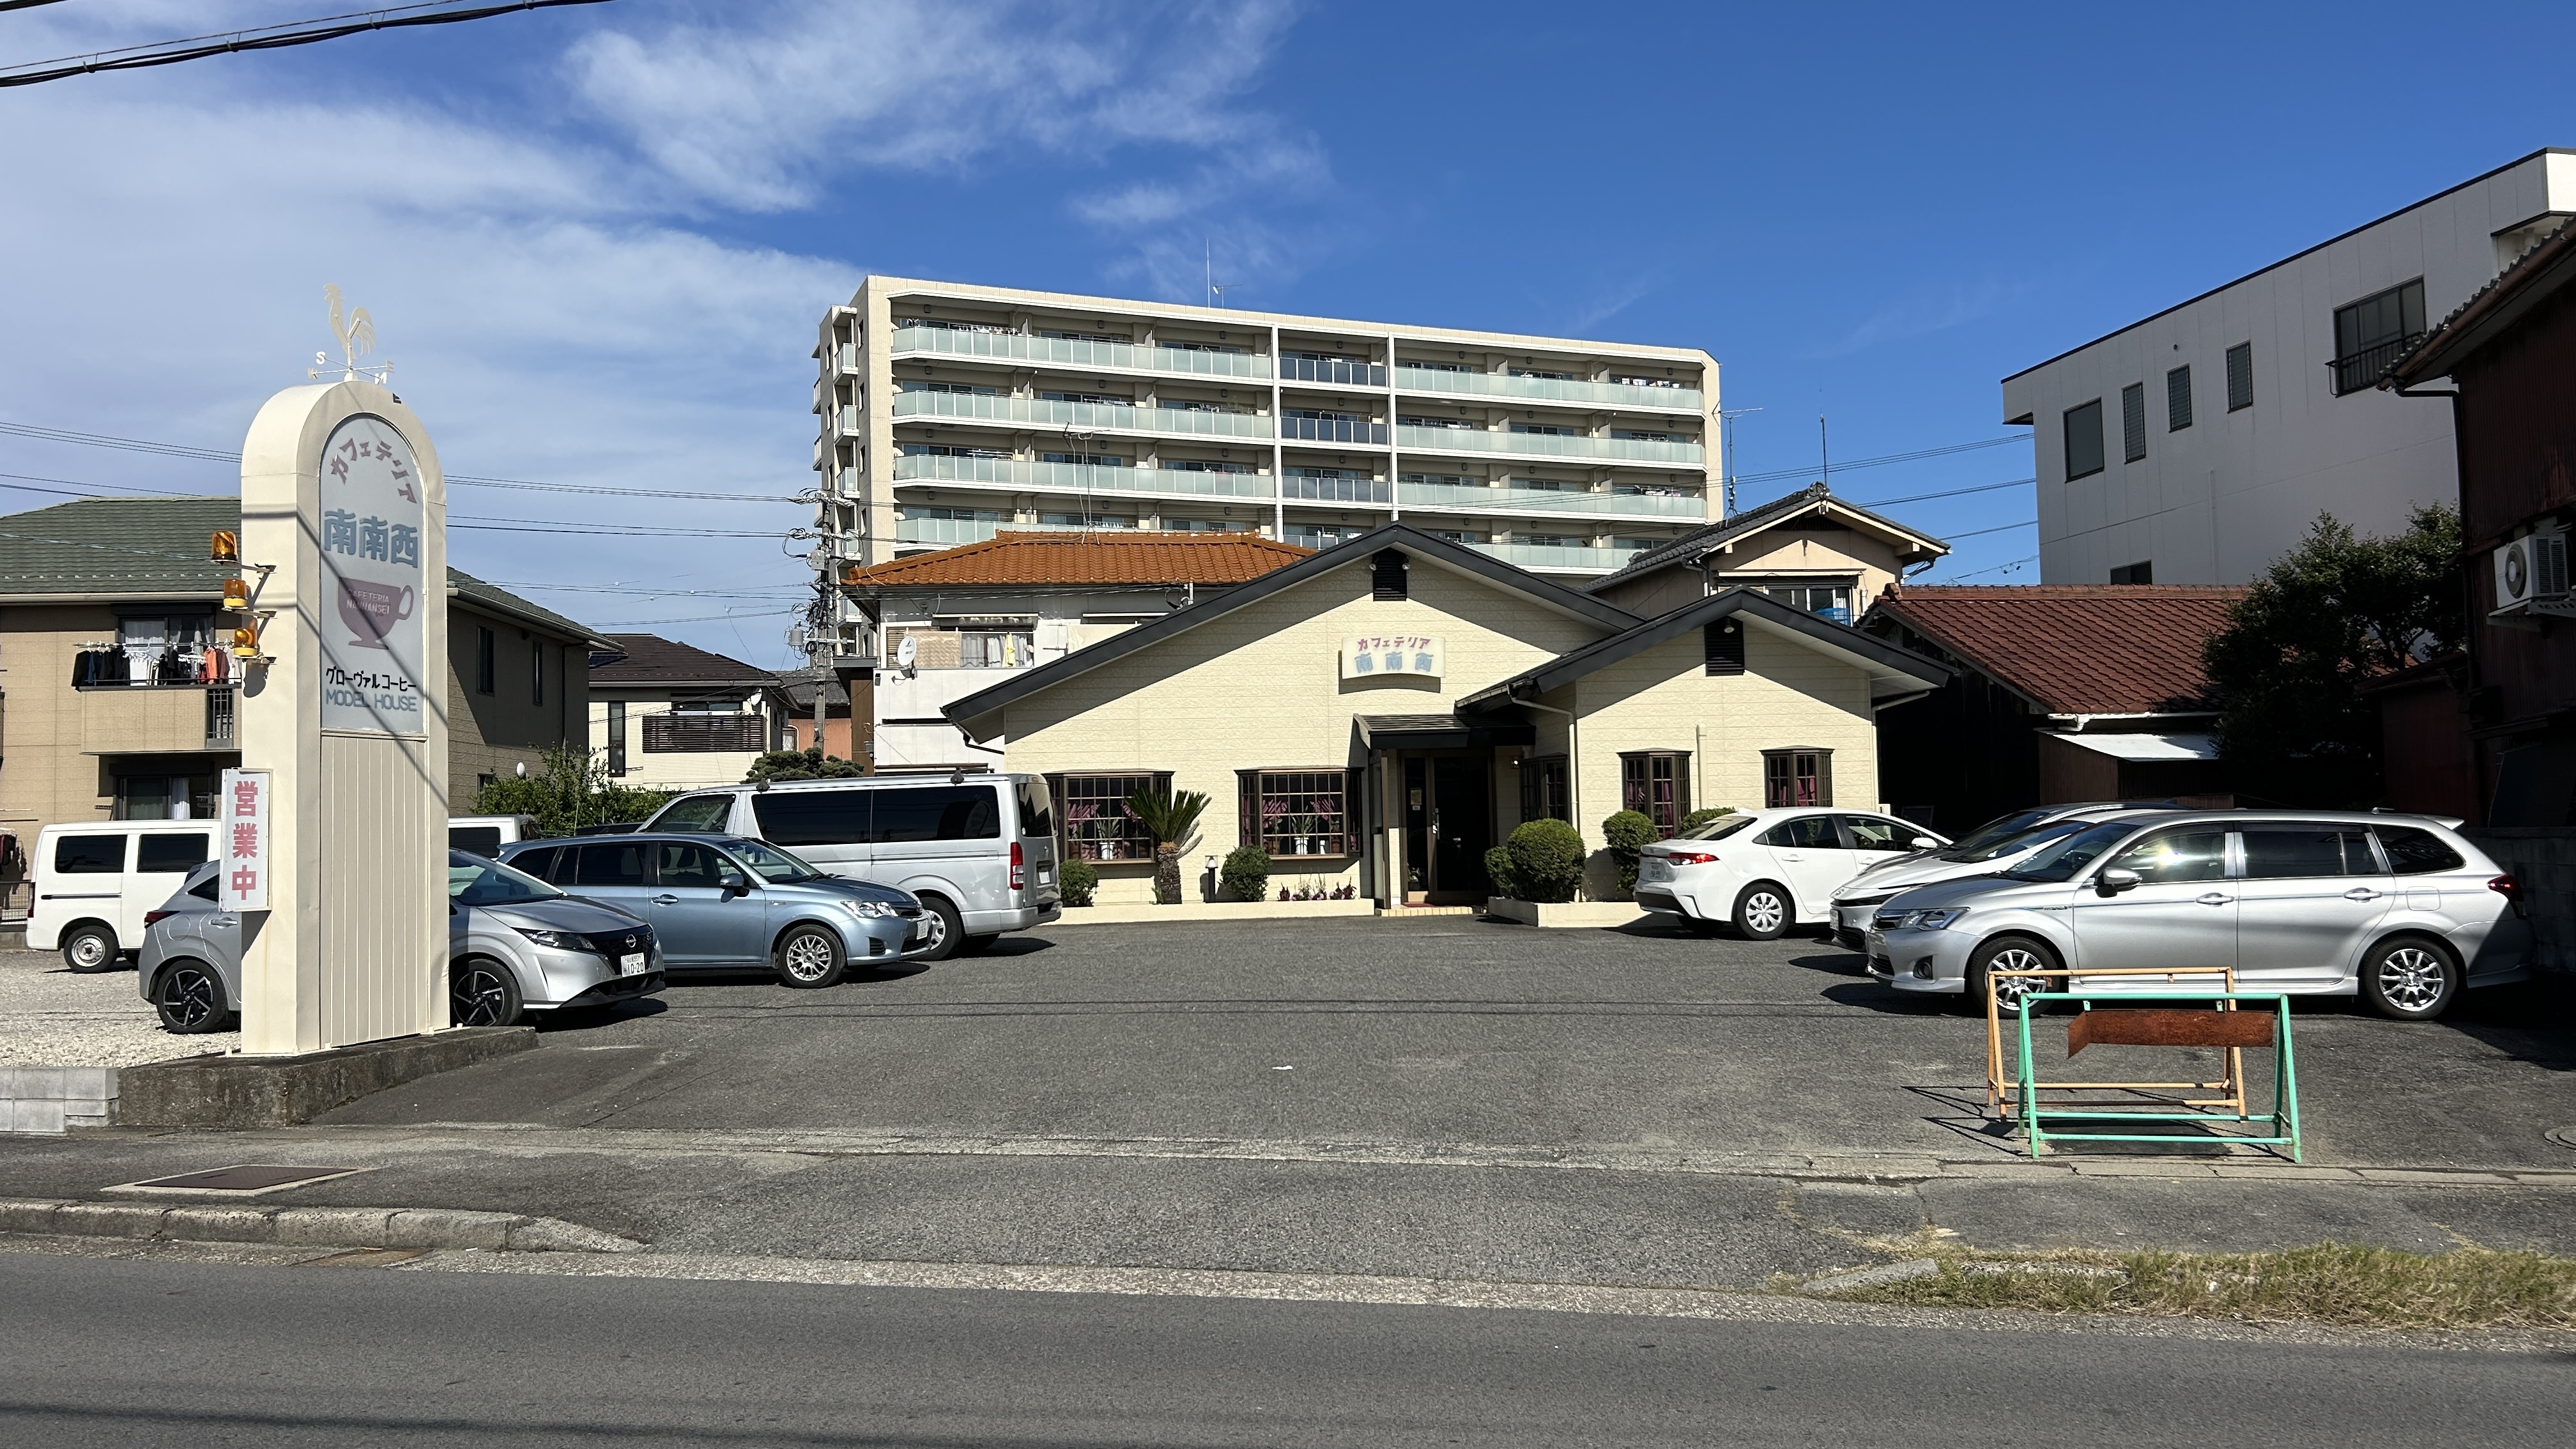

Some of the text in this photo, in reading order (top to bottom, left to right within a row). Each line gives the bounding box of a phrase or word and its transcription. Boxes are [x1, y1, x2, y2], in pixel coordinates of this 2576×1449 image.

[316, 351, 326, 365] S
[331, 438, 417, 503] カフェテリア
[324, 509, 418, 568] 南南西
[1357, 636, 1431, 651] カフェテリア
[1354, 651, 1434, 673] 南南西
[326, 666, 417, 692] グローヴァルコーヒー
[326, 688, 417, 712] MODEL HOUSE
[232, 781, 258, 900] 営業中
[627, 962, 644, 975] 10-20
